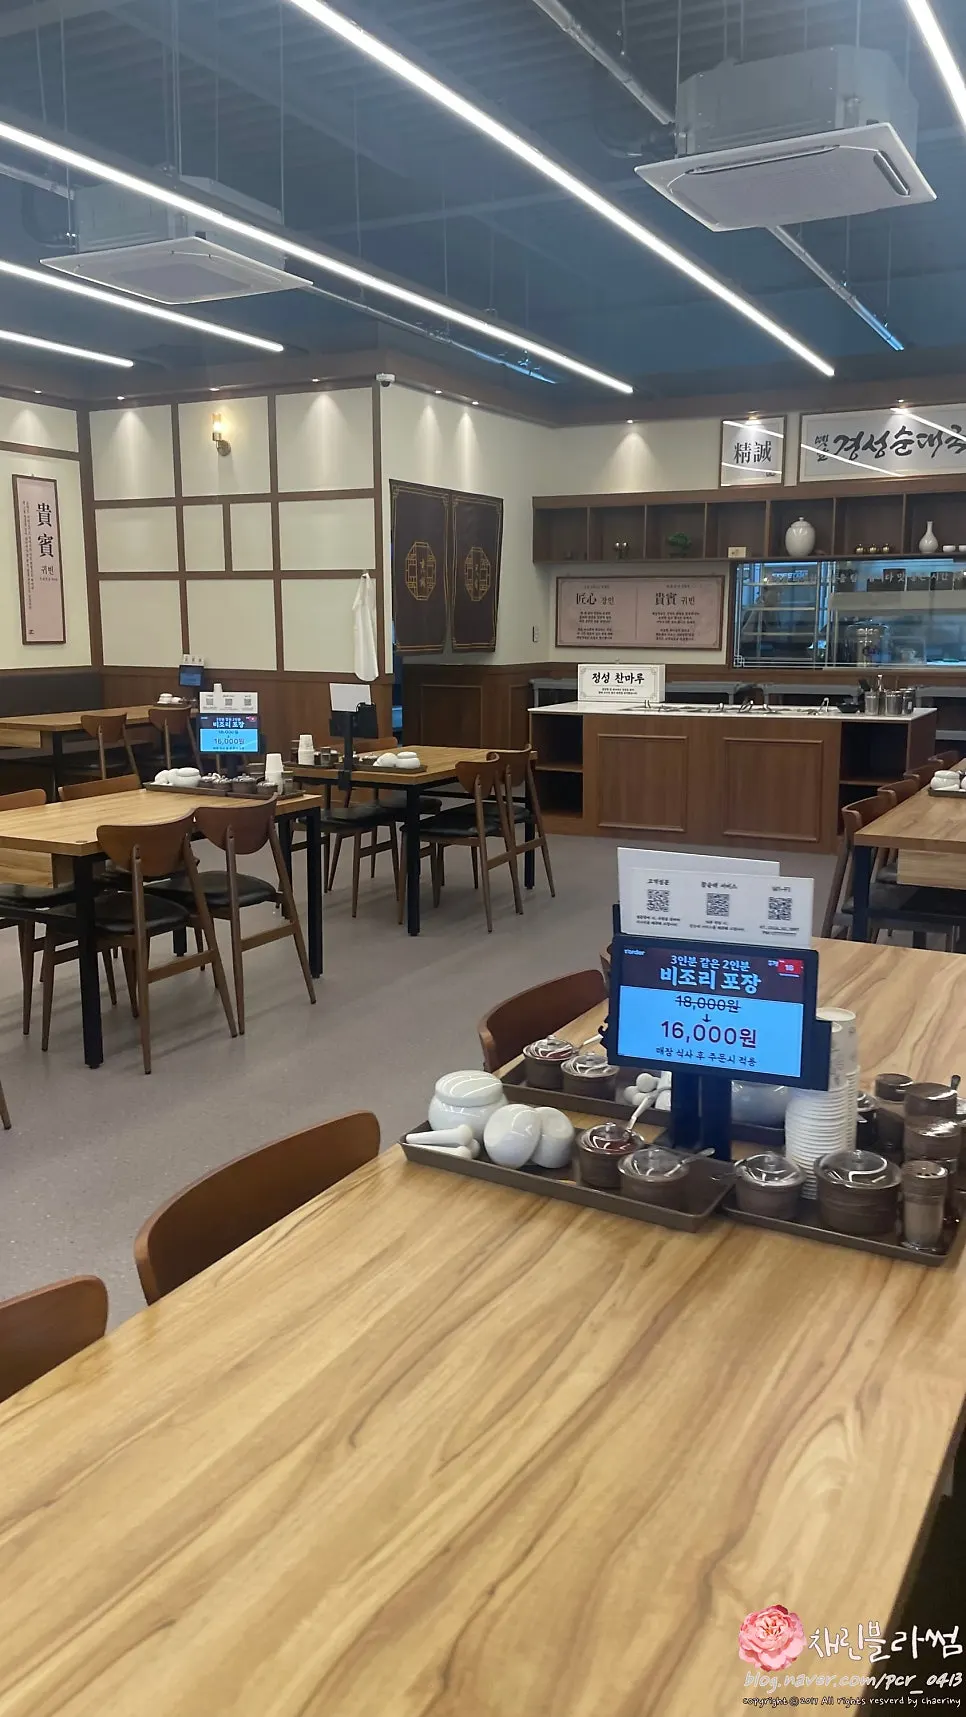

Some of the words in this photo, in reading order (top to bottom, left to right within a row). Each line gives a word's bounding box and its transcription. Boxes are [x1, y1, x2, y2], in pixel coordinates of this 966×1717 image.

[734, 440, 772, 464] 精誠
[592, 671, 610, 684] 정성
[614, 672, 645, 685] 찬마루
[670, 955, 698, 968] 3인분
[699, 957, 720, 969] 같은
[722, 959, 751, 973] 2인분
[660, 966, 716, 990] 비조리
[720, 972, 762, 995] 포장
[674, 994, 741, 1013] 18,000원
[661, 1020, 757, 1049] 16,000원
[656, 1046, 673, 1057] 매장
[676, 1048, 694, 1059] 식사
[696, 1050, 705, 1061] 후
[739, 1056, 758, 1067] 적용
